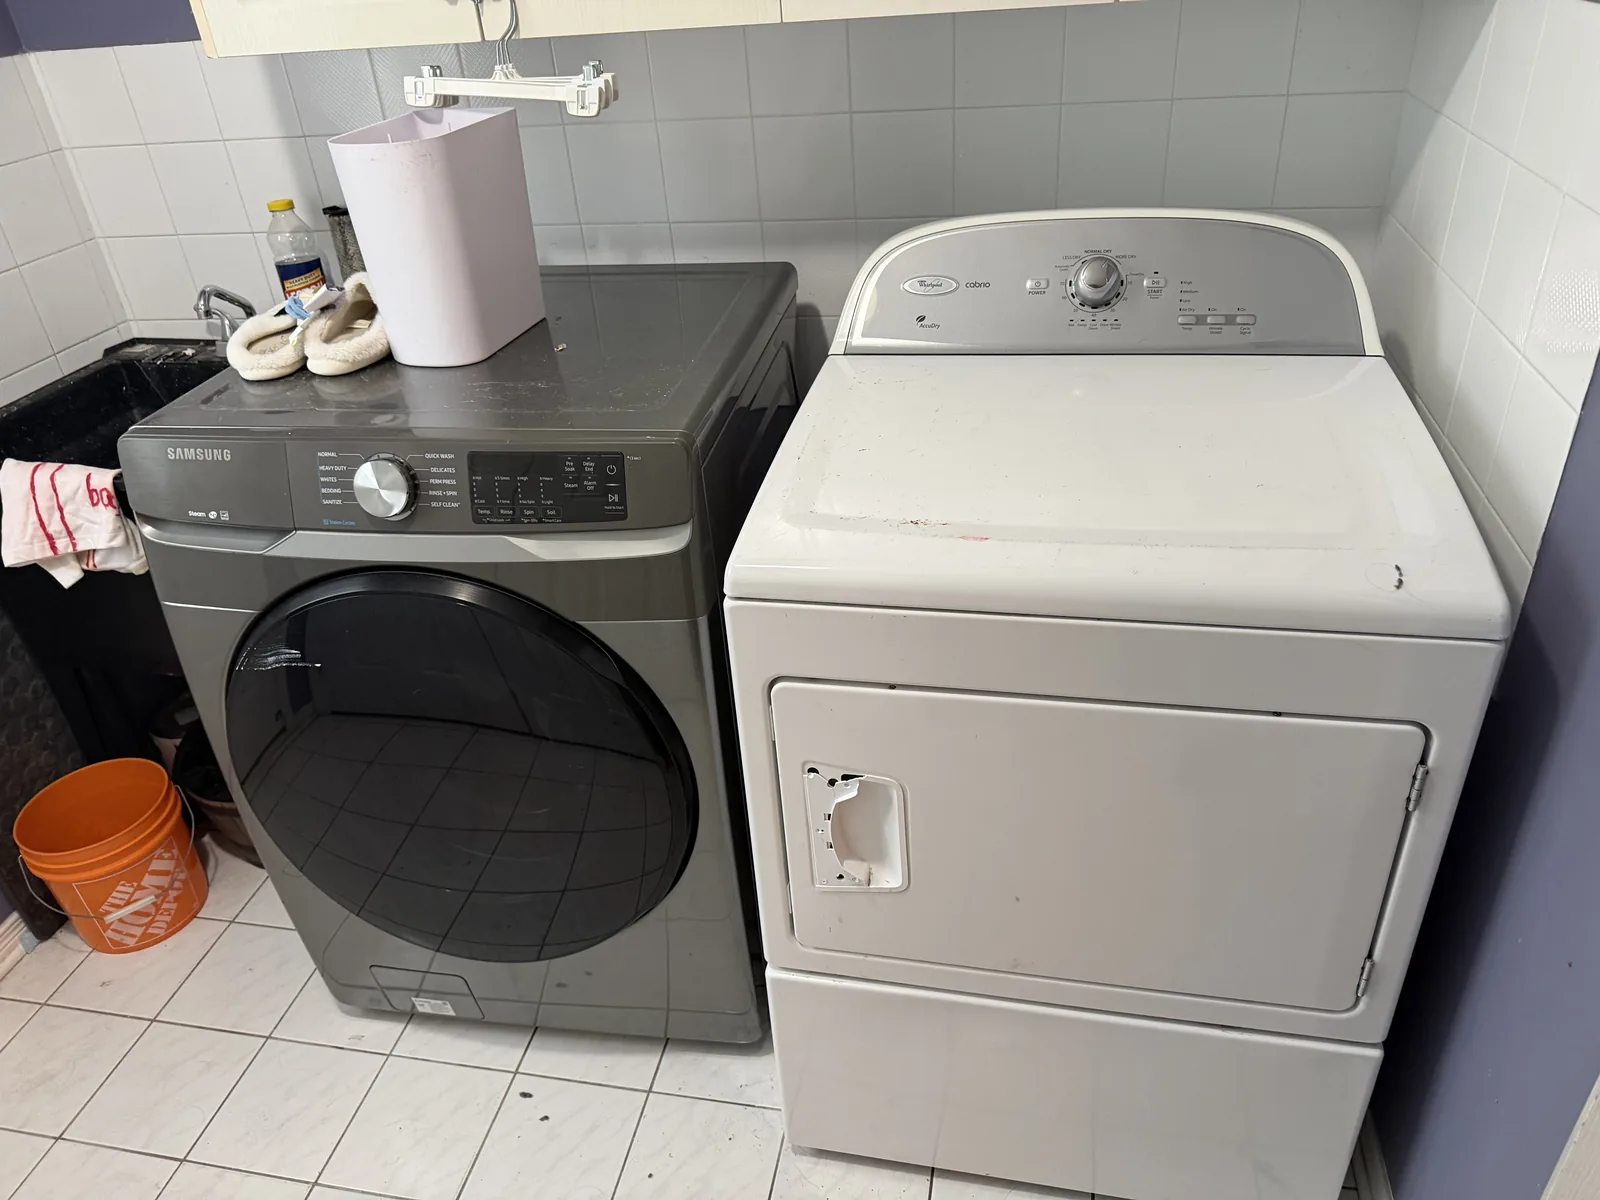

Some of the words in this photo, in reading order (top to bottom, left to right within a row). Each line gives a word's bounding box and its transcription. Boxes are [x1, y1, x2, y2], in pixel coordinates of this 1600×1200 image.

[918, 281, 943, 289] Whirlpool
[965, 280, 991, 289] cabrio
[919, 322, 941, 330] AccuDry
[167, 447, 232, 461] SAMSUNG
[188, 510, 207, 518] Steam
[99, 881, 138, 912] THE
[104, 848, 179, 946] HOME
